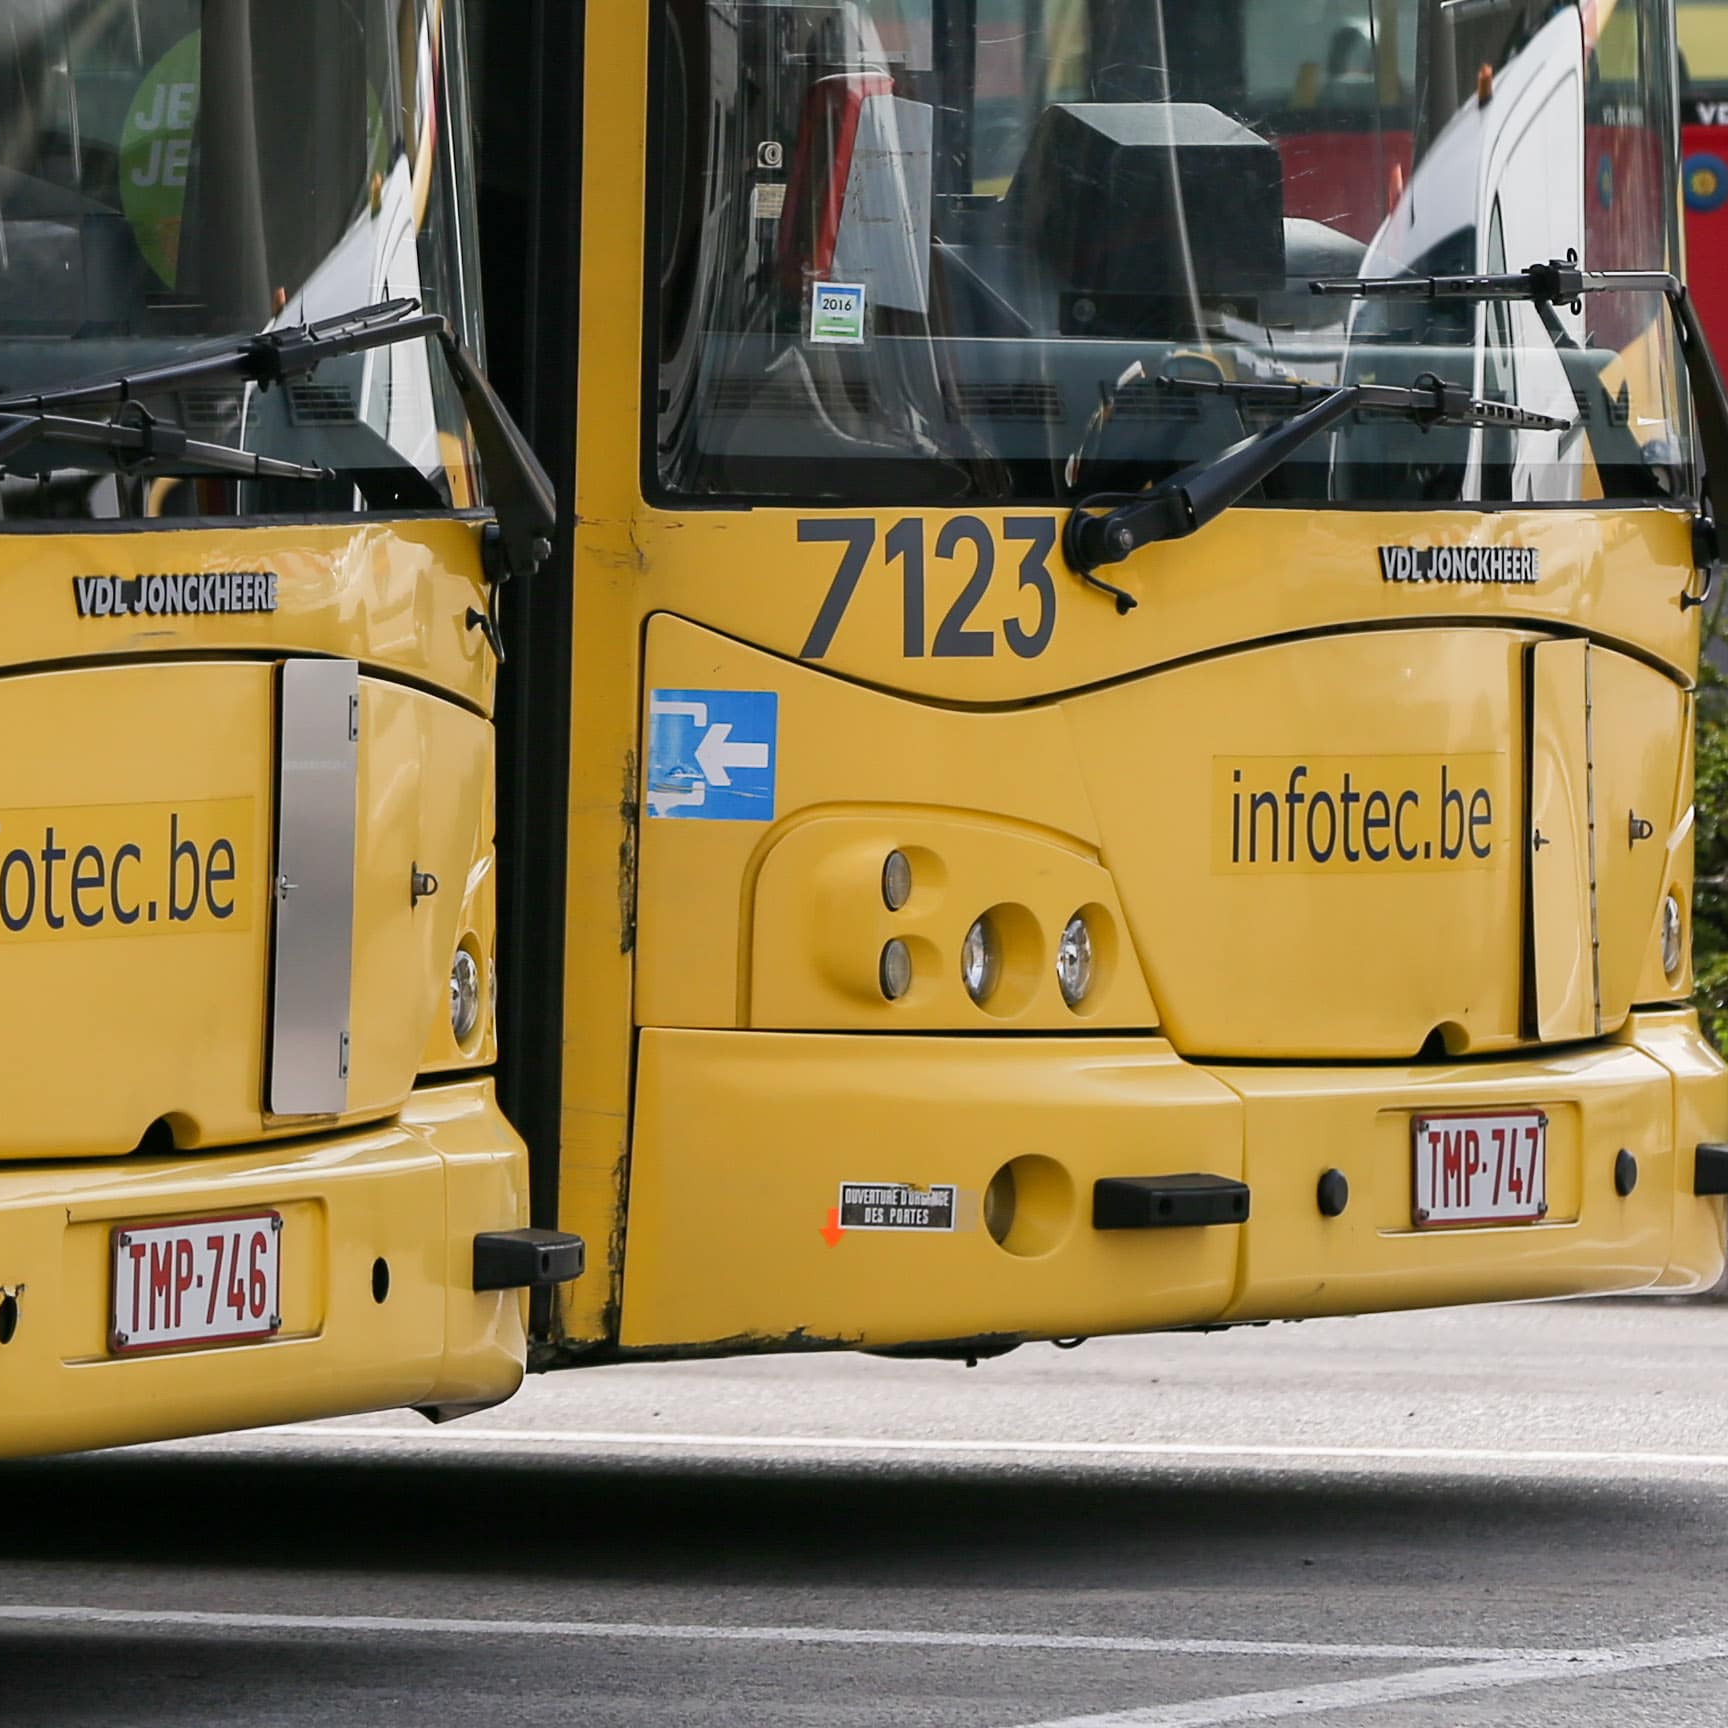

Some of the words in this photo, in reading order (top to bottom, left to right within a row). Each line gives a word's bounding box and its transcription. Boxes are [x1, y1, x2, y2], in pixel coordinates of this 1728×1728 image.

[135, 83, 194, 130] JE
[131, 139, 190, 187] JE
[822, 298, 852, 311] 2016
[796, 515, 1056, 659] 7123
[1379, 547, 1425, 583] VDL
[1425, 547, 1539, 584] JONCKHEERE
[73, 575, 130, 618] VDL
[131, 571, 278, 615] JONCKHEERE
[1229, 764, 1495, 865] infotec.be
[1428, 1127, 1539, 1209] TMP-747
[864, 1208, 884, 1223] DES
[889, 1209, 929, 1225] PORTES
[129, 1231, 268, 1333] TMP-746
